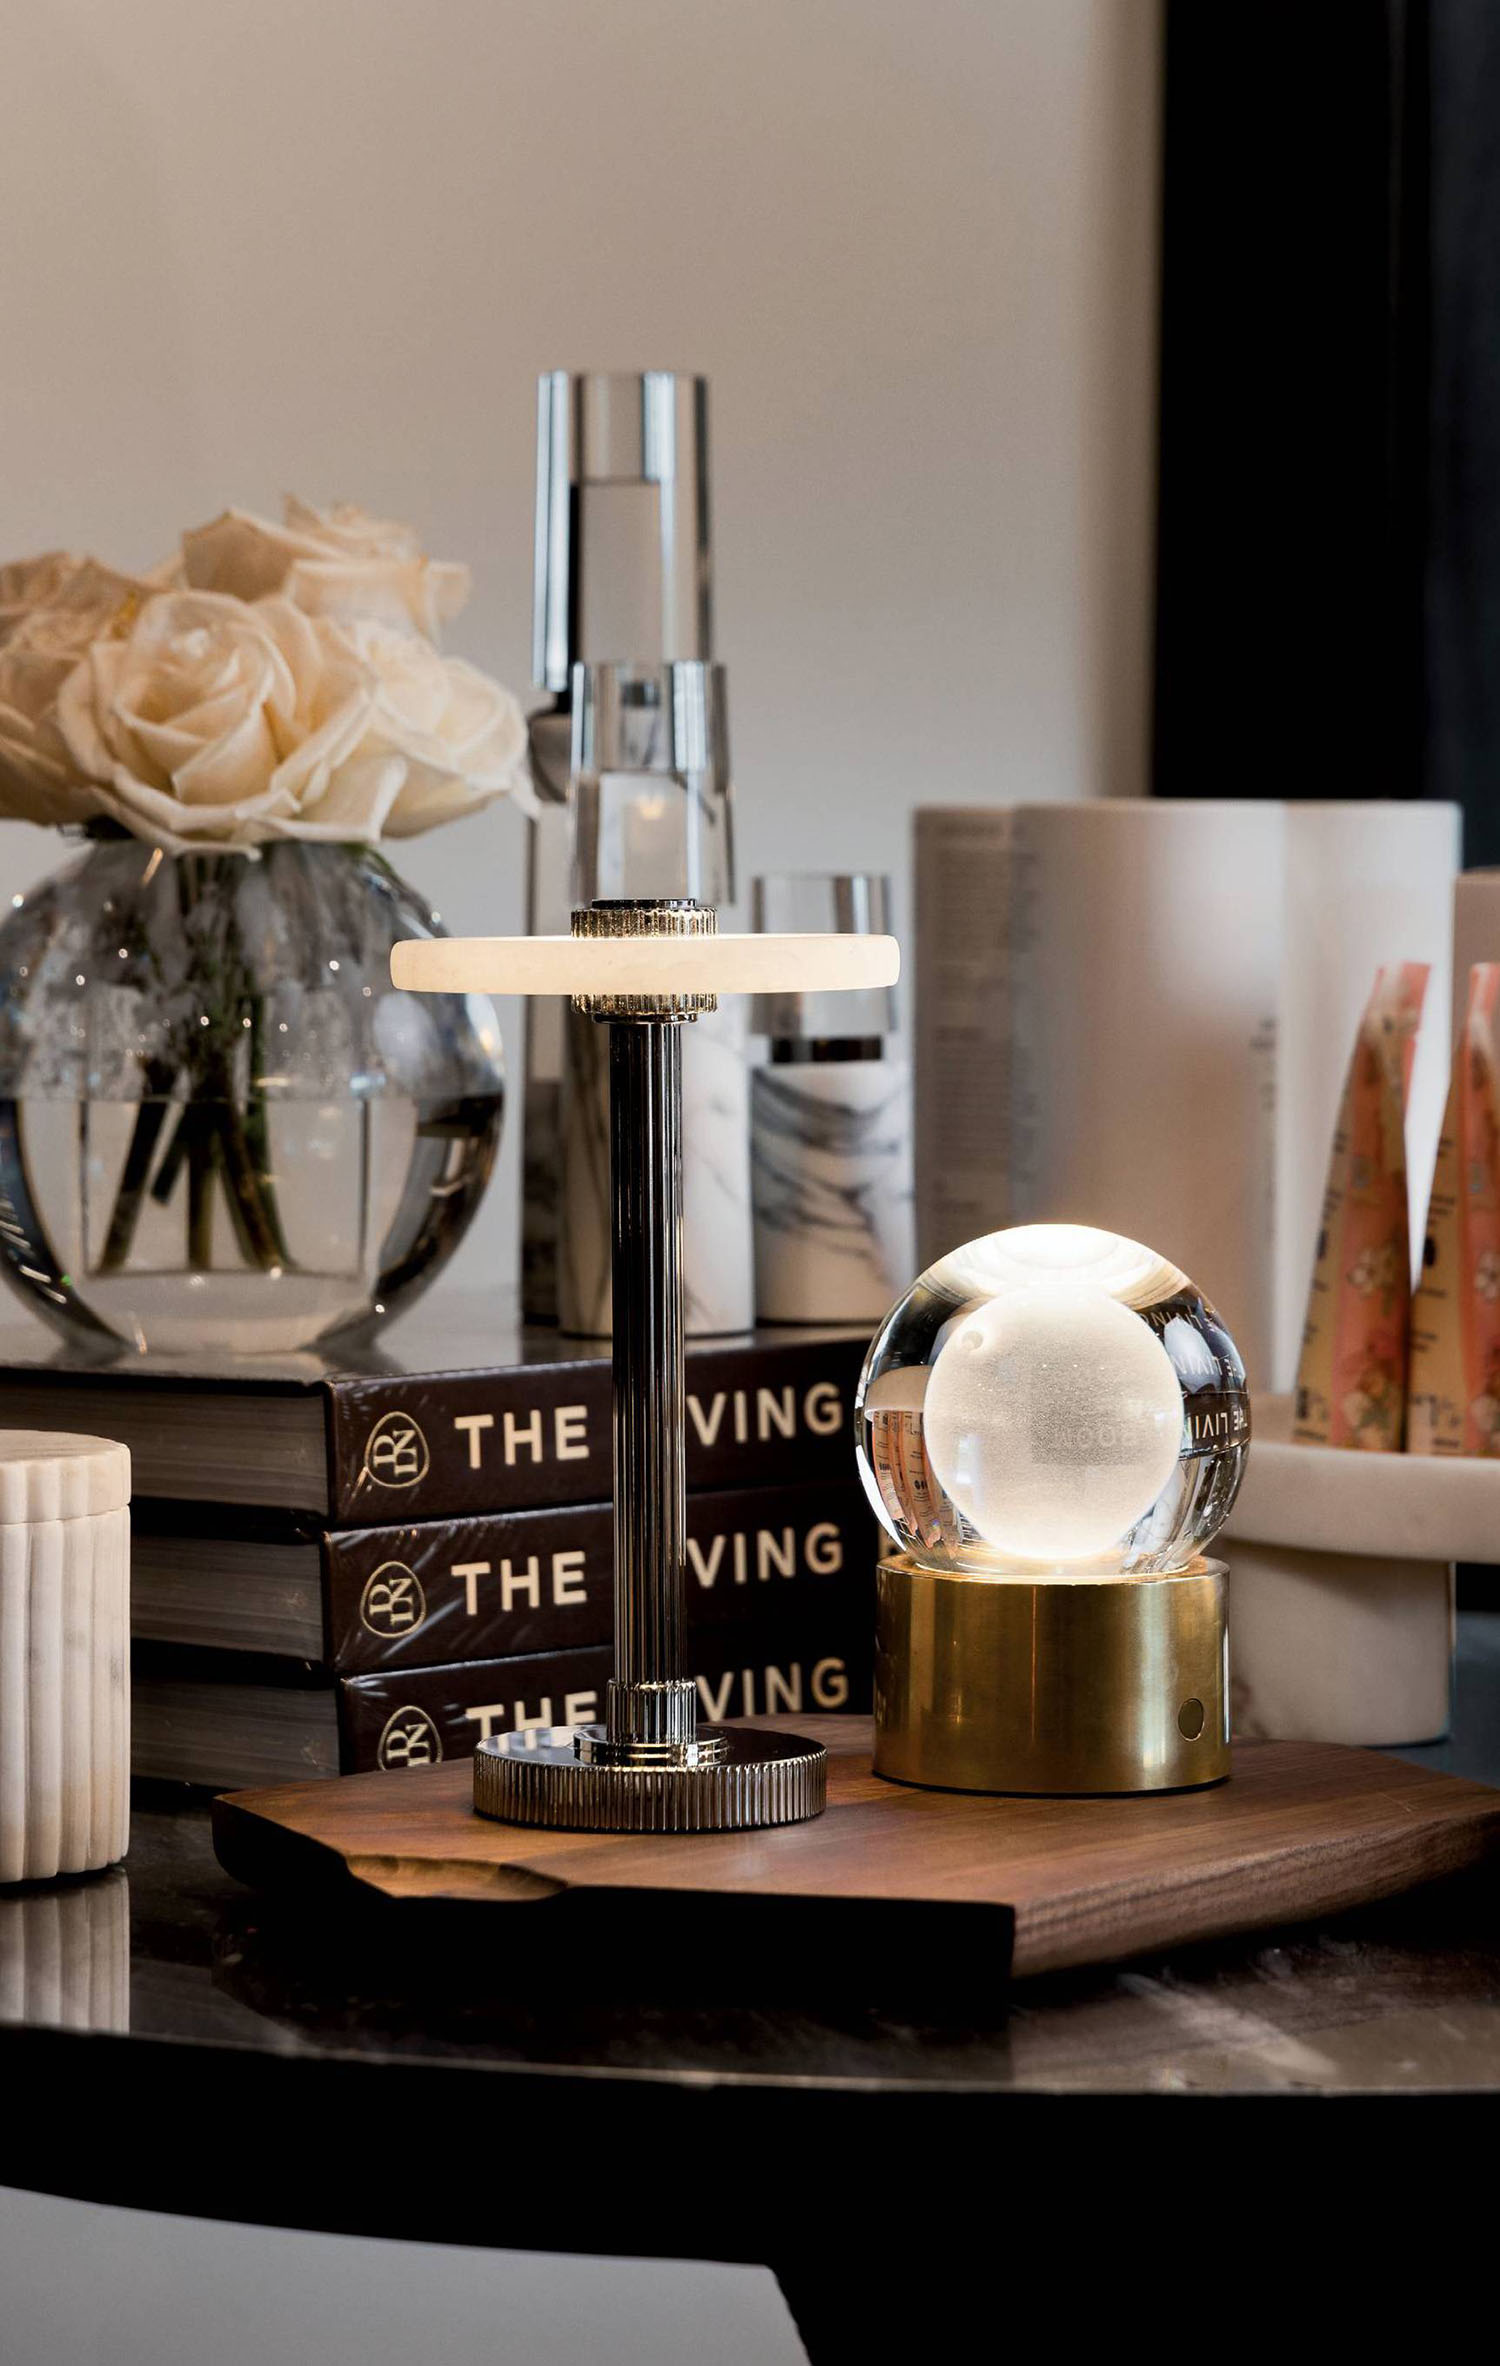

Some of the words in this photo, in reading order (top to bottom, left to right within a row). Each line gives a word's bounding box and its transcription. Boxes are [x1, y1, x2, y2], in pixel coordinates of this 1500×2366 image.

[454, 1405, 590, 1469] THE
[686, 1381, 844, 1447] VING
[451, 1550, 587, 1616] THE
[686, 1521, 844, 1588] VING
[465, 1690, 597, 1740] THE
[694, 1656, 849, 1722] VING
